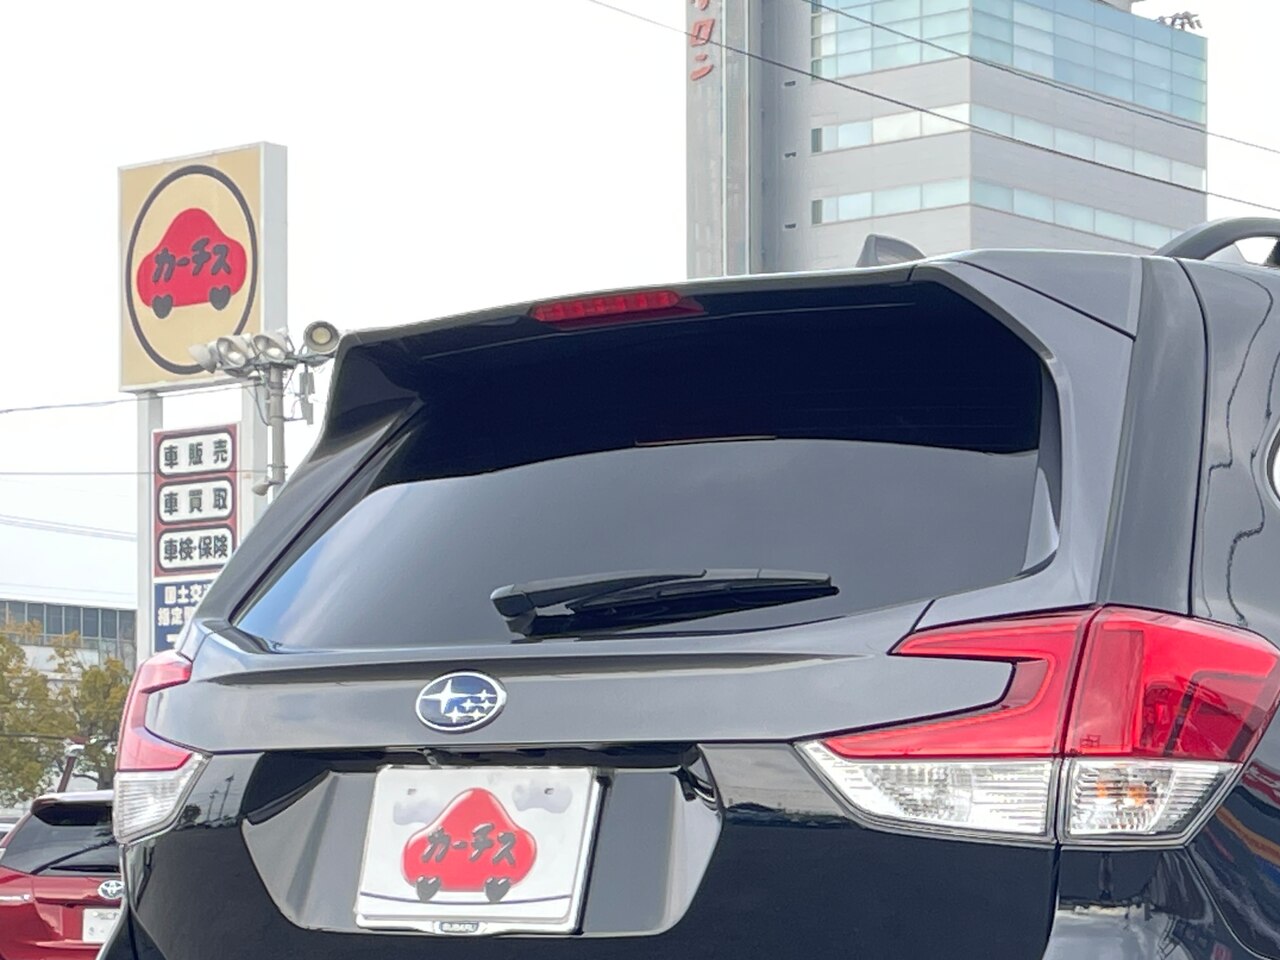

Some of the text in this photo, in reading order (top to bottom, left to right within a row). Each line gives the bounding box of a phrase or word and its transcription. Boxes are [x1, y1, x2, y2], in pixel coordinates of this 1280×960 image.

[152, 237, 231, 283] カーチス
[163, 439, 228, 469] 車販売
[163, 487, 228, 516] 車買取
[421, 823, 516, 866] カーチス
